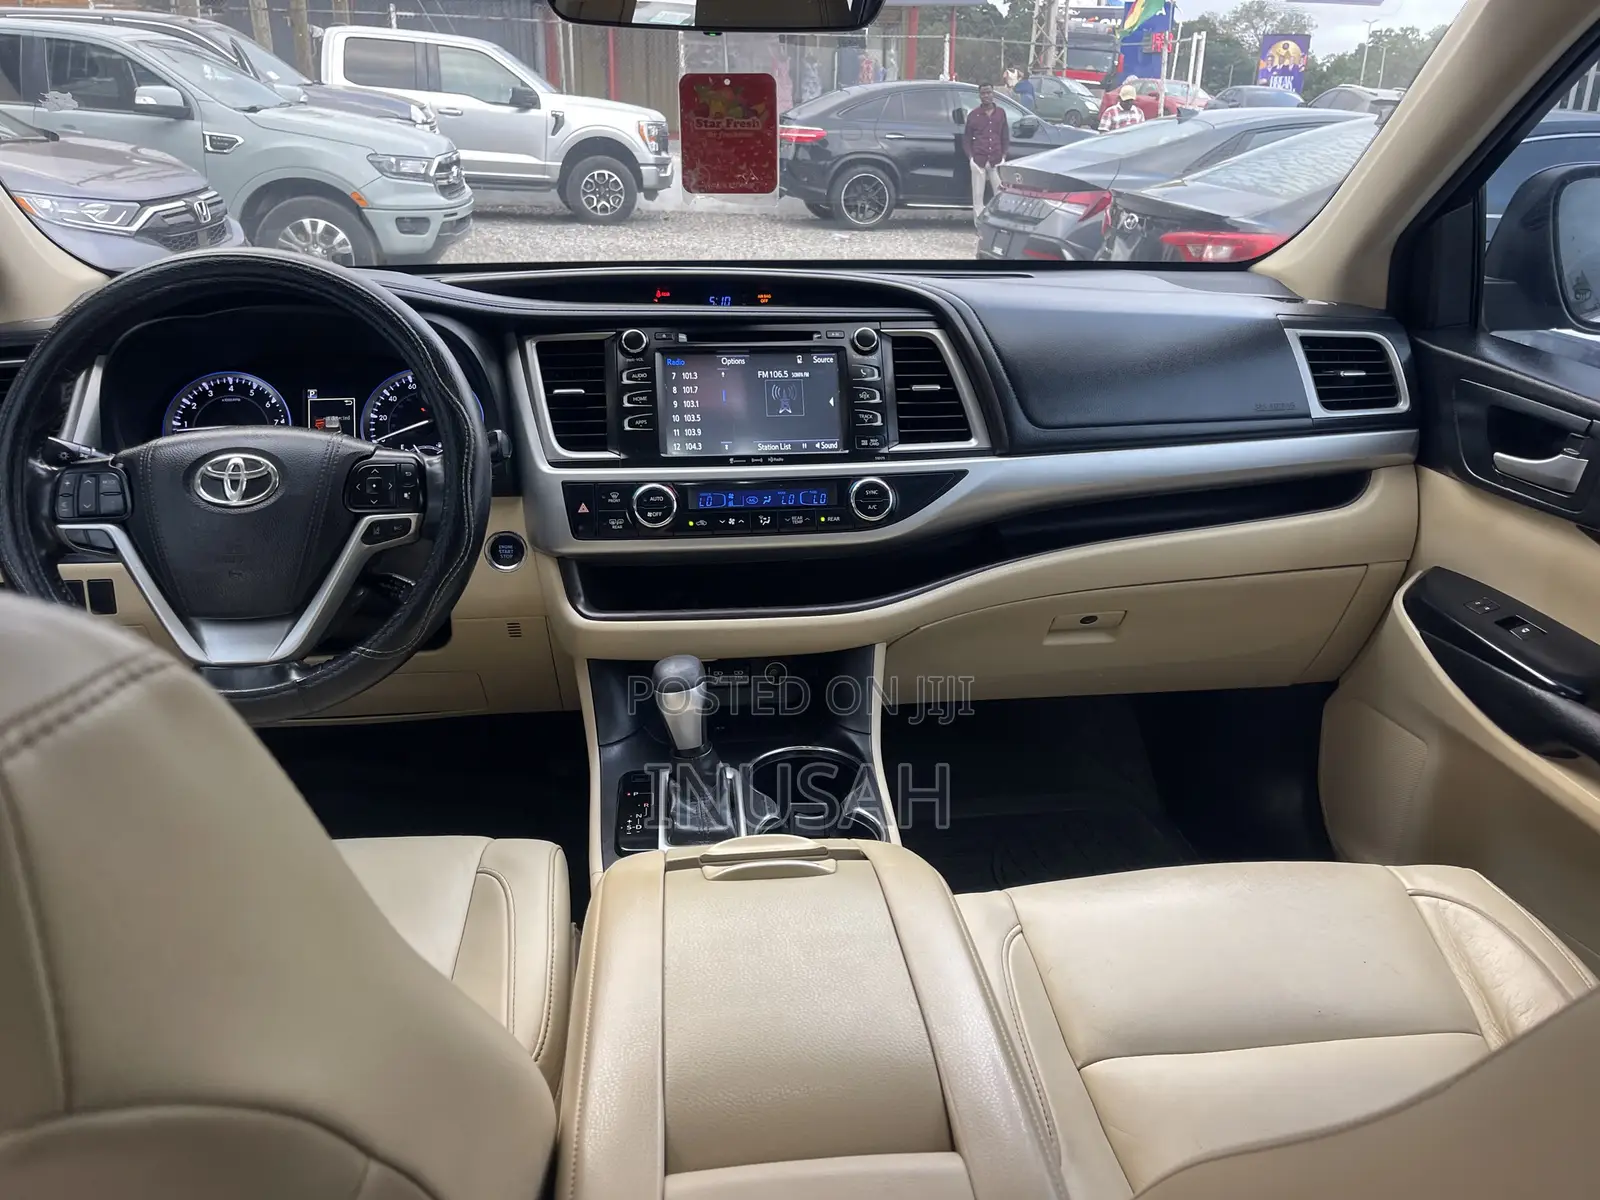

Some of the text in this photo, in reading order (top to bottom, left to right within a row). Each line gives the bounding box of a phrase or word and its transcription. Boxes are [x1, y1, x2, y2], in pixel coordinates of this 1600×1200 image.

[694, 118, 760, 128] Star Fresh
[709, 296, 731, 306] 5:10
[666, 358, 686, 366] Radio
[721, 357, 746, 366] Options
[812, 356, 834, 364] Source
[671, 372, 698, 380] 7 101.3
[757, 370, 769, 378] FM
[769, 370, 789, 378] 106.5
[672, 386, 698, 394] 8 101.7
[672, 400, 699, 408] 9 103.1
[672, 414, 701, 422] 10 103.5
[673, 443, 702, 451] 12 104.3
[757, 443, 792, 451] Station List
[821, 441, 838, 449] Sound
